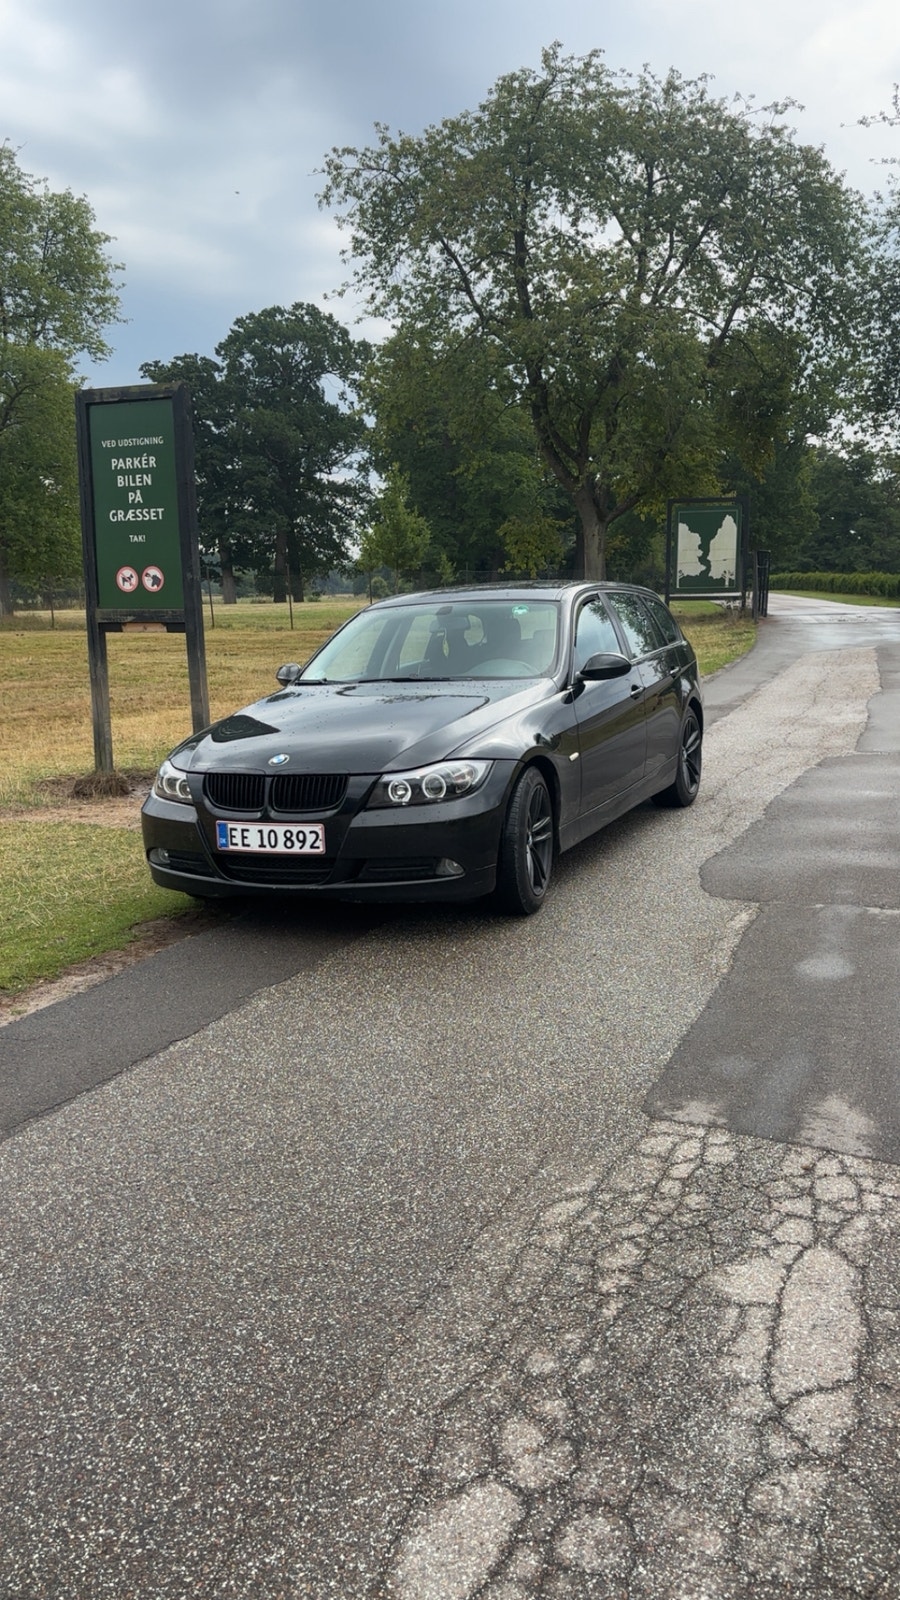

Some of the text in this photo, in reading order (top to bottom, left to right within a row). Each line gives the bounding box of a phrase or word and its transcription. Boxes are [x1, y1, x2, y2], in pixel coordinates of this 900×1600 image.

[102, 436, 164, 448] VED UDSTIGNING
[111, 453, 157, 470] PARKÉR
[117, 474, 152, 487] BILEN
[128, 489, 143, 504] PÅ
[109, 508, 164, 522] GRÆSSET
[229, 828, 321, 850] EE 10 892
